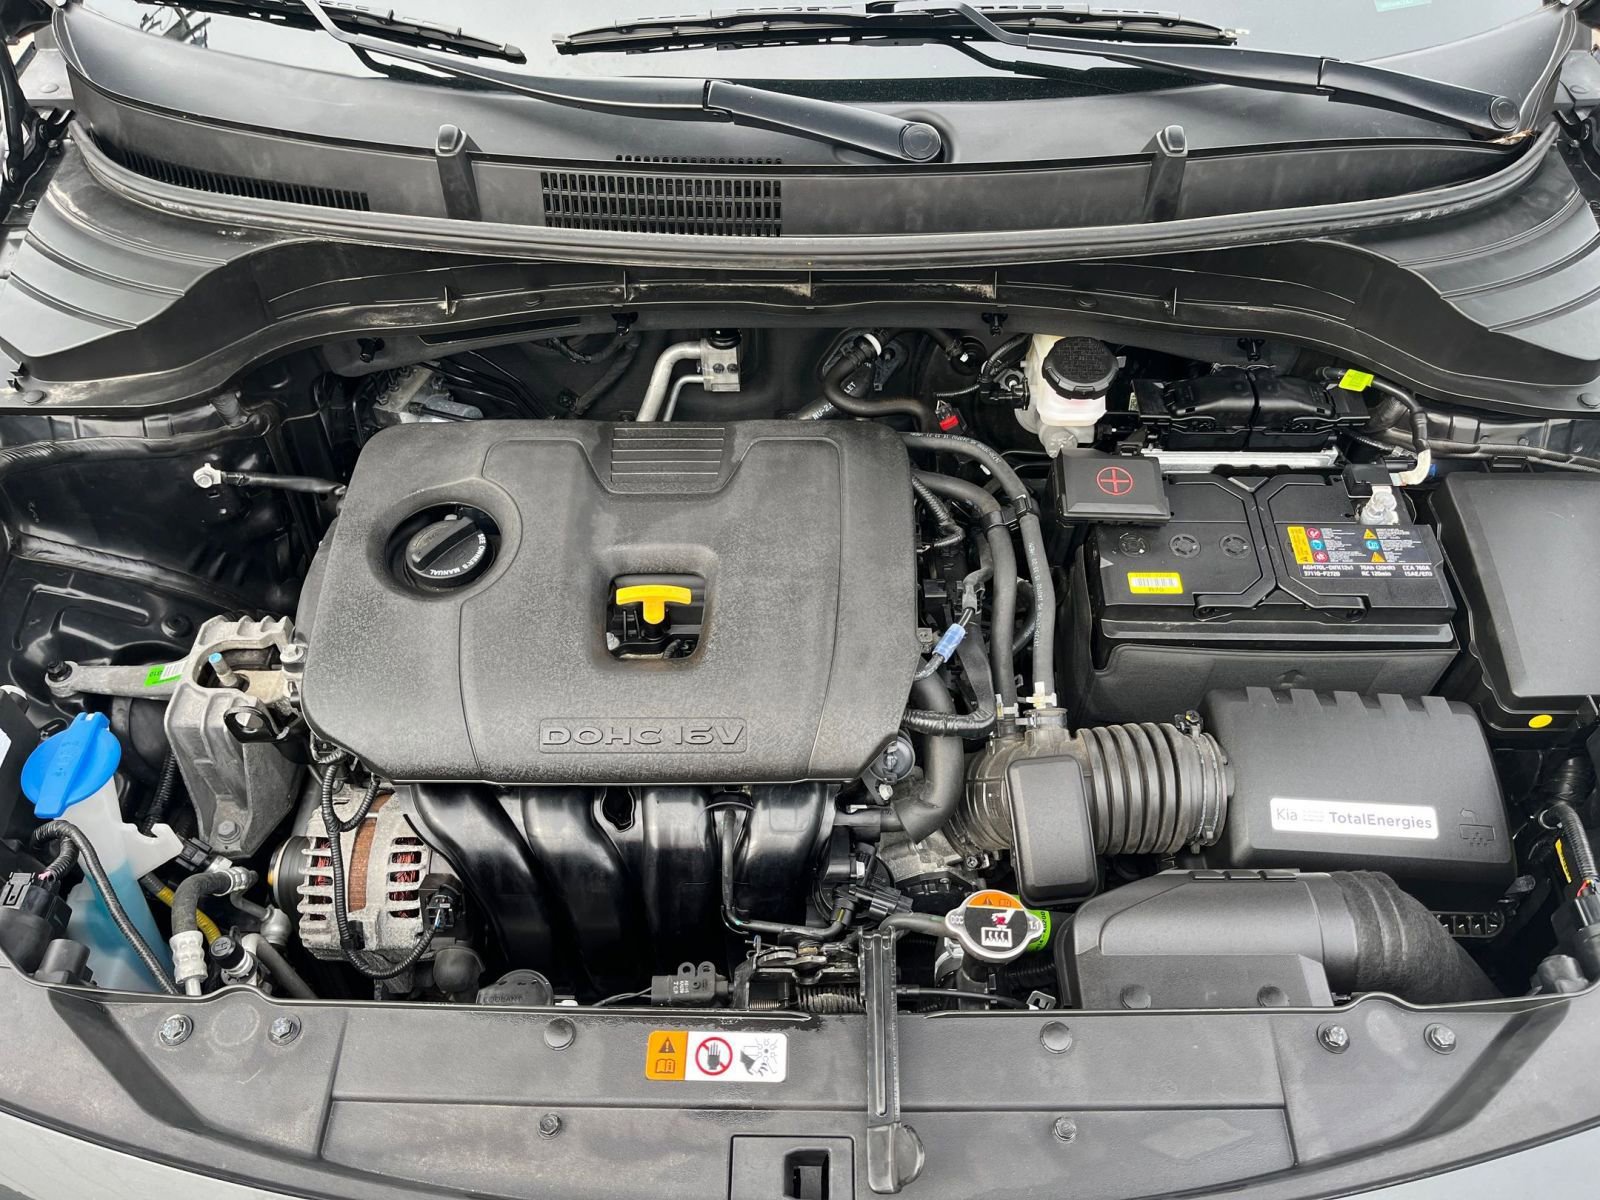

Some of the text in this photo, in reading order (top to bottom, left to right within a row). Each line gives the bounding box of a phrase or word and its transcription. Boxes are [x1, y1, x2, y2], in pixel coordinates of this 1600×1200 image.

[429, 533, 487, 576] SEE OWNER'S MANUAL
[542, 725, 745, 746] DOHC 16V
[1276, 808, 1298, 822] Kia
[1329, 811, 1433, 830] TotalEnergies
